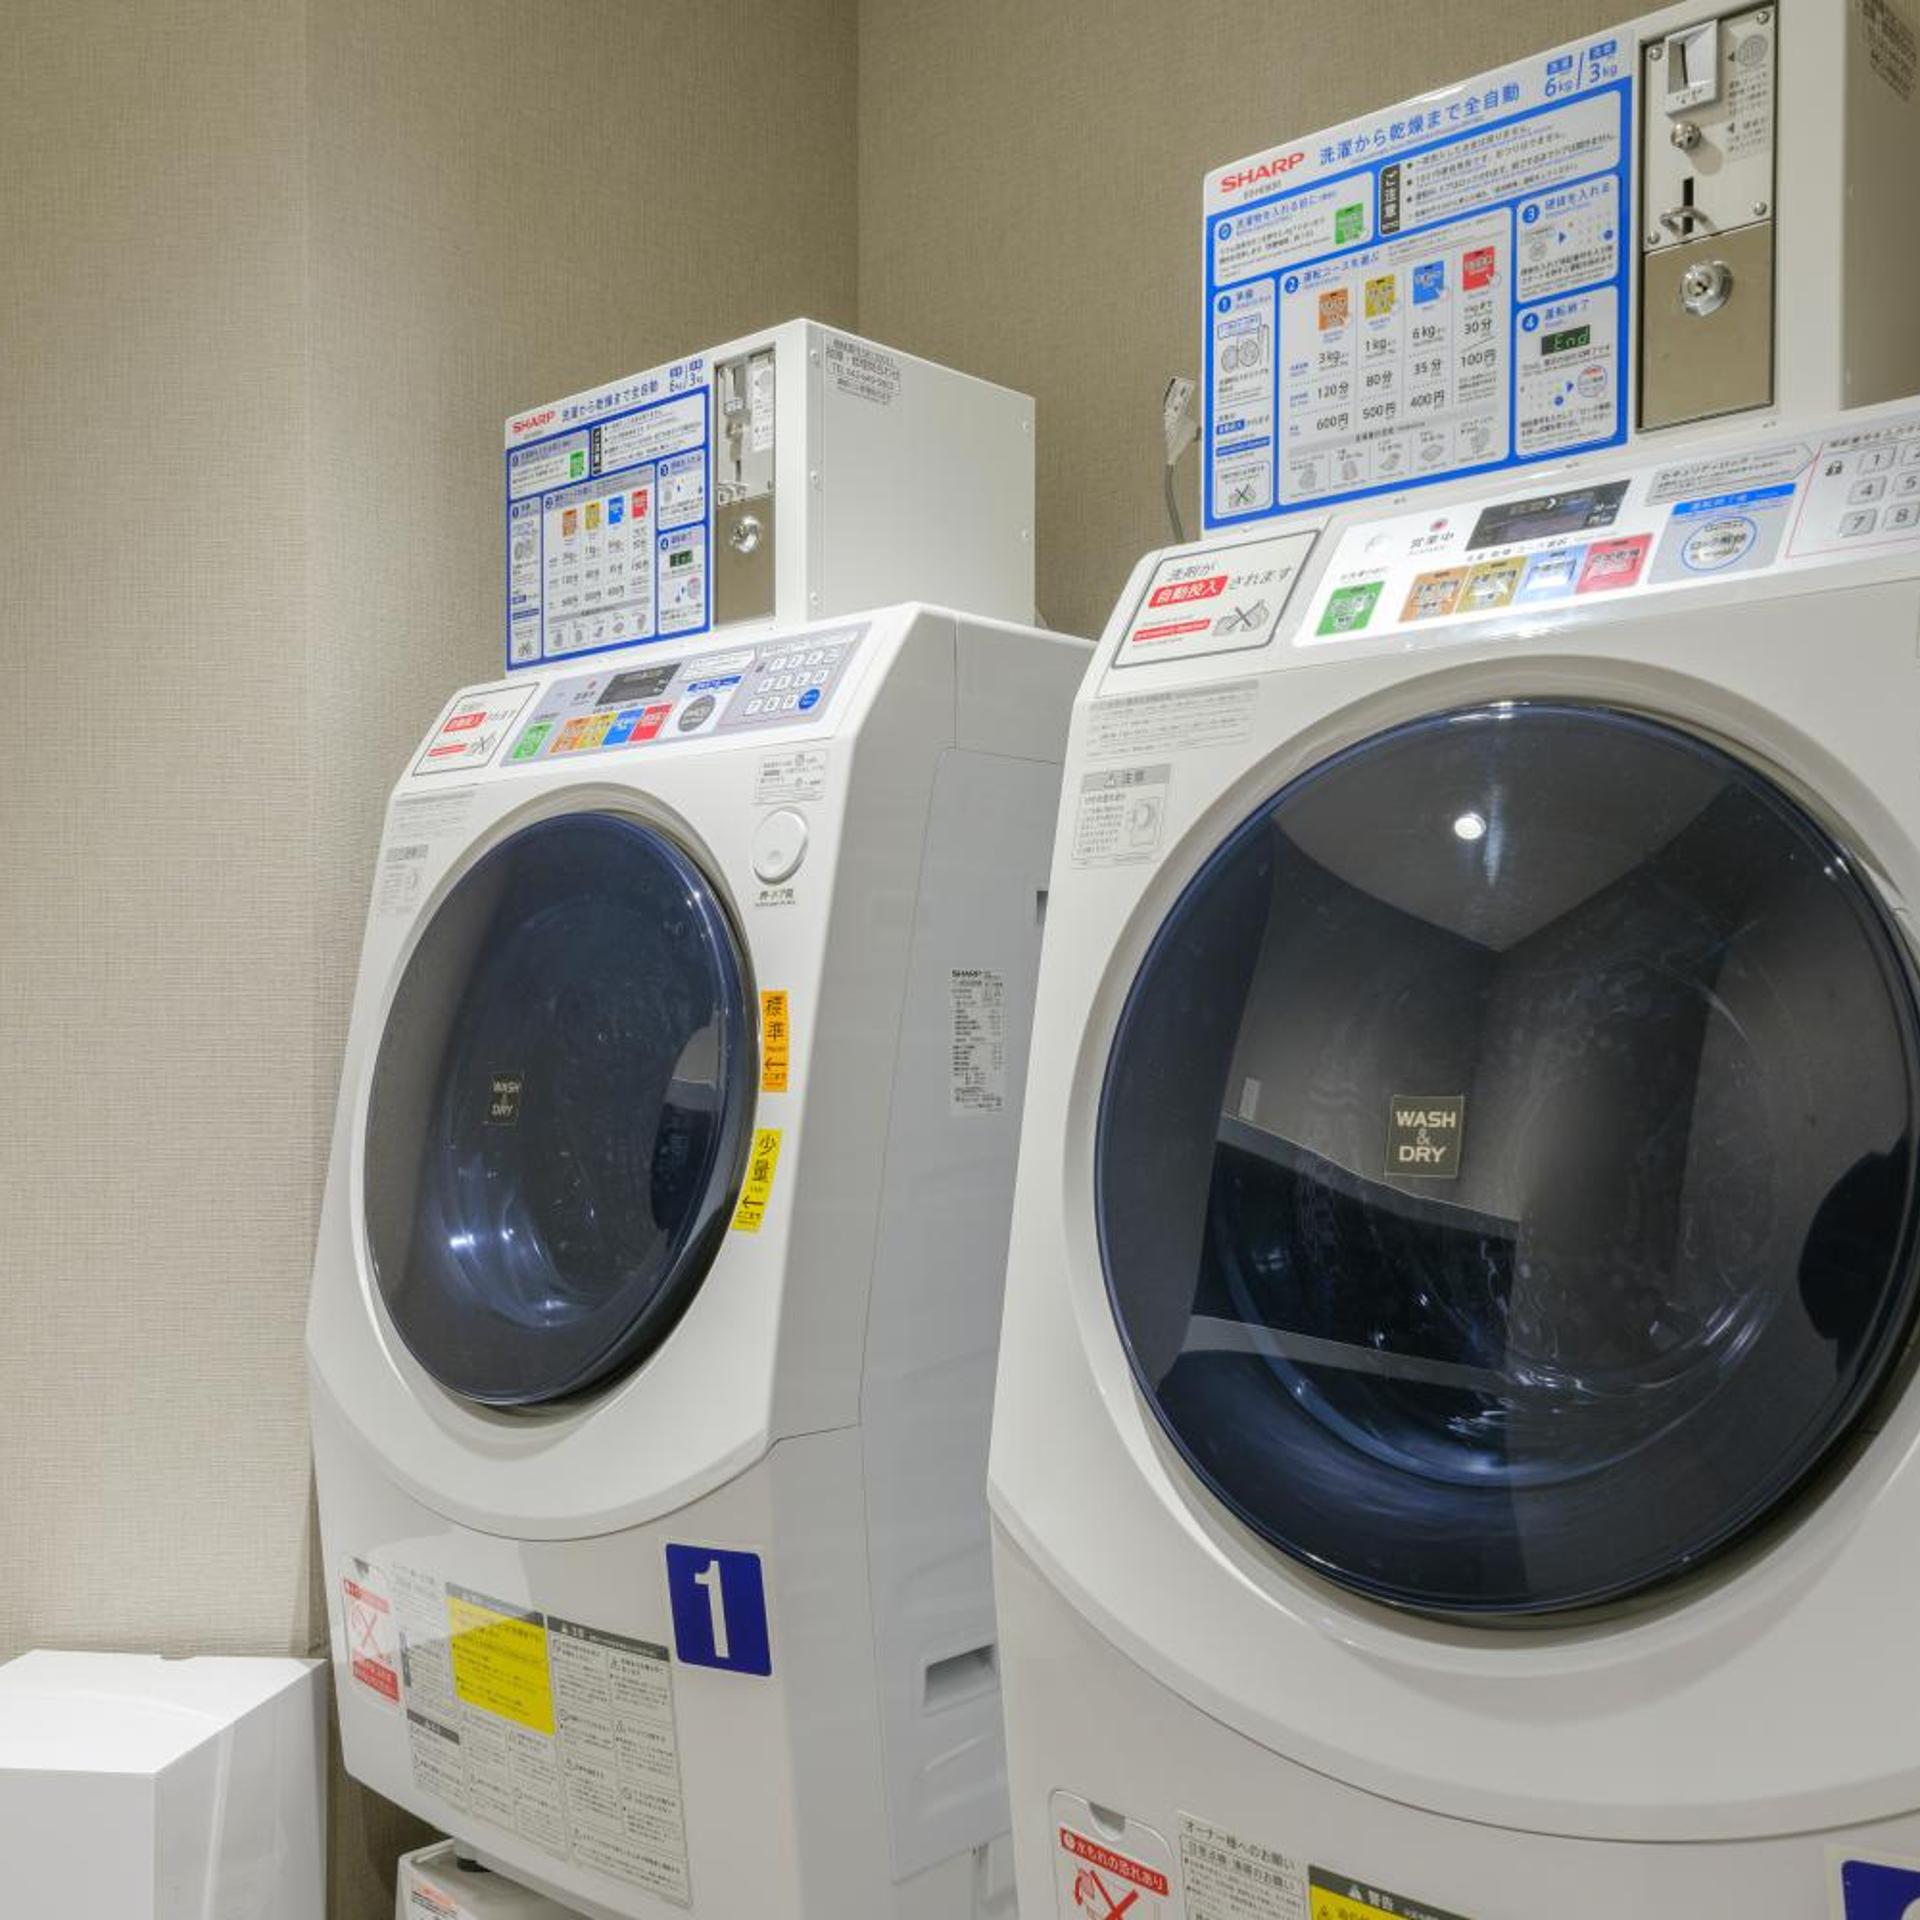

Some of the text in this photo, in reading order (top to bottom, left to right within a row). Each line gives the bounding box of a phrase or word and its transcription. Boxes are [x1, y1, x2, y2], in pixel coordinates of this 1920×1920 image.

[1319, 82, 1520, 165] 洗濯から乾燥まで全自動
[1220, 151, 1305, 193] SHARP
[1464, 319, 1493, 335] 30分
[1413, 359, 1441, 375] 35分
[1460, 349, 1497, 367] 100円
[1366, 371, 1393, 387] 80分
[1317, 382, 1349, 399] 120分
[1410, 390, 1445, 408] 400円
[1362, 402, 1396, 420] 500円
[512, 411, 555, 433] SHARP
[1316, 413, 1349, 431] 600円
[1158, 582, 1220, 604] 自動投入
[766, 996, 783, 1041] 標準
[492, 1081, 520, 1093] WASH
[1395, 1111, 1457, 1128] WASH
[1416, 1128, 1431, 1145] &
[753, 1136, 776, 1183] 少量
[1399, 1146, 1447, 1163] DRY
[694, 1560, 730, 1659] 1
